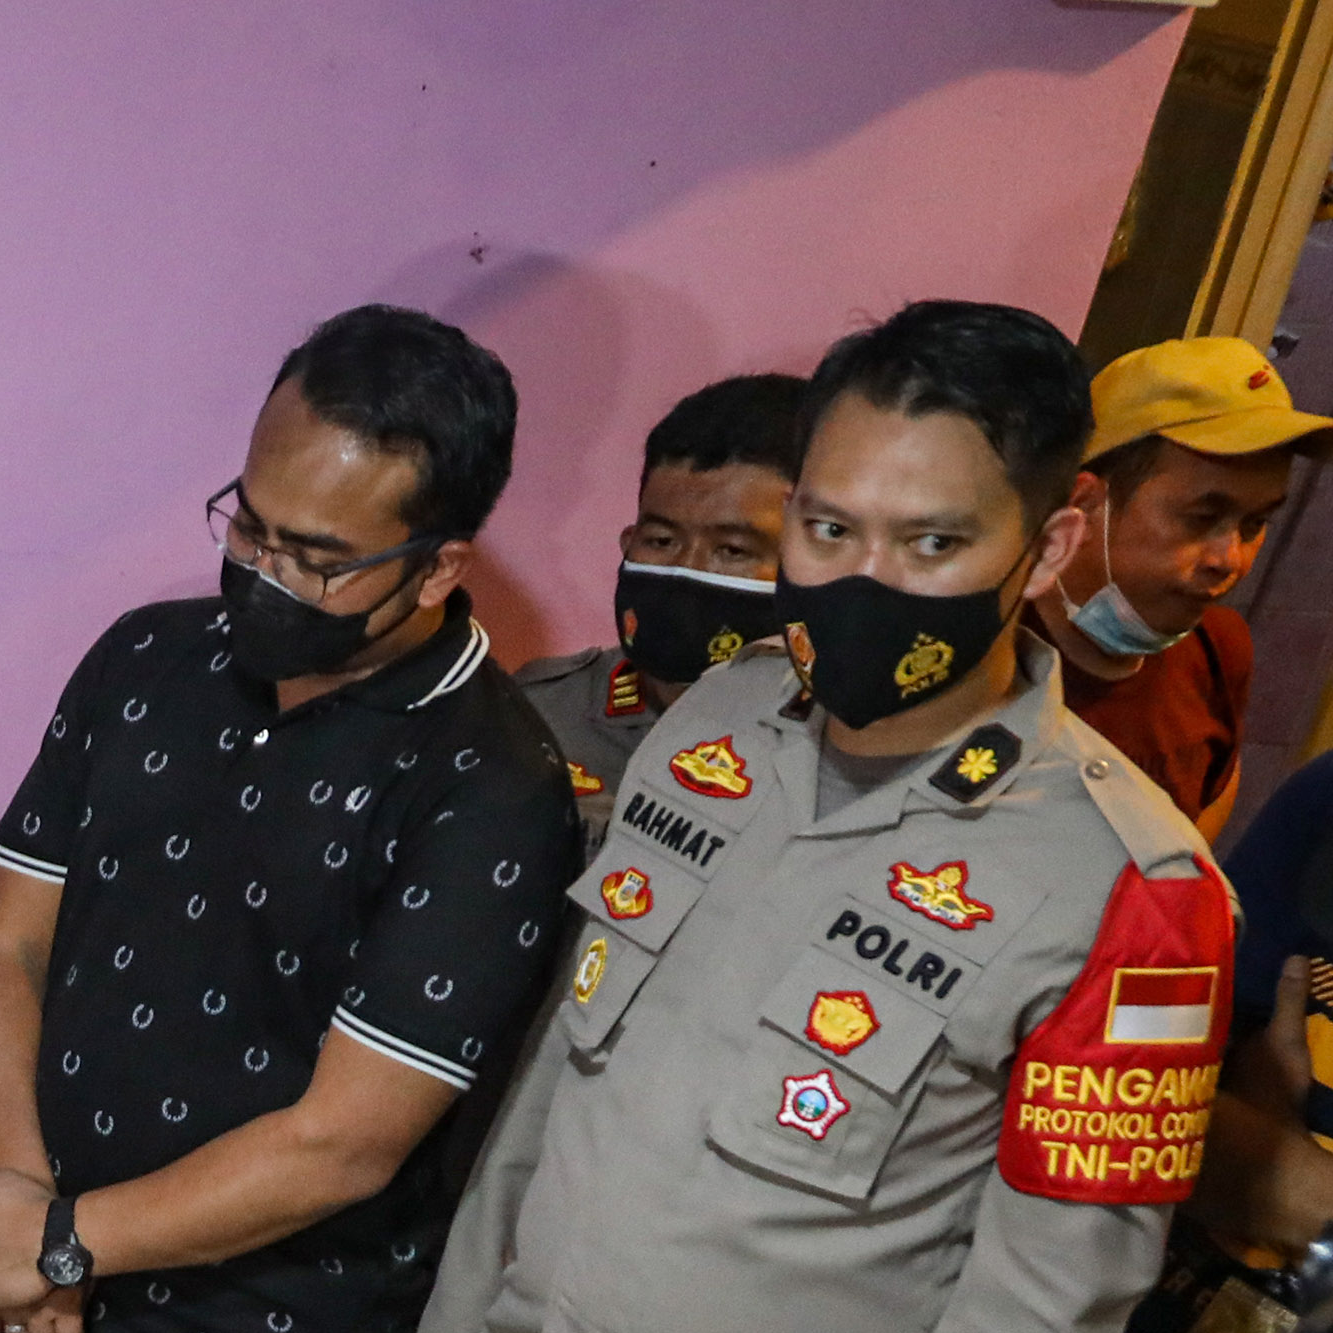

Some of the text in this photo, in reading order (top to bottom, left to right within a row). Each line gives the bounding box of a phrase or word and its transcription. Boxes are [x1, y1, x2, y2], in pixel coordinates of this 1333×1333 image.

[622, 792, 726, 867] RAHMAT
[826, 910, 962, 999] POLRI
[1018, 1103, 1159, 1139] PROTOKOL
